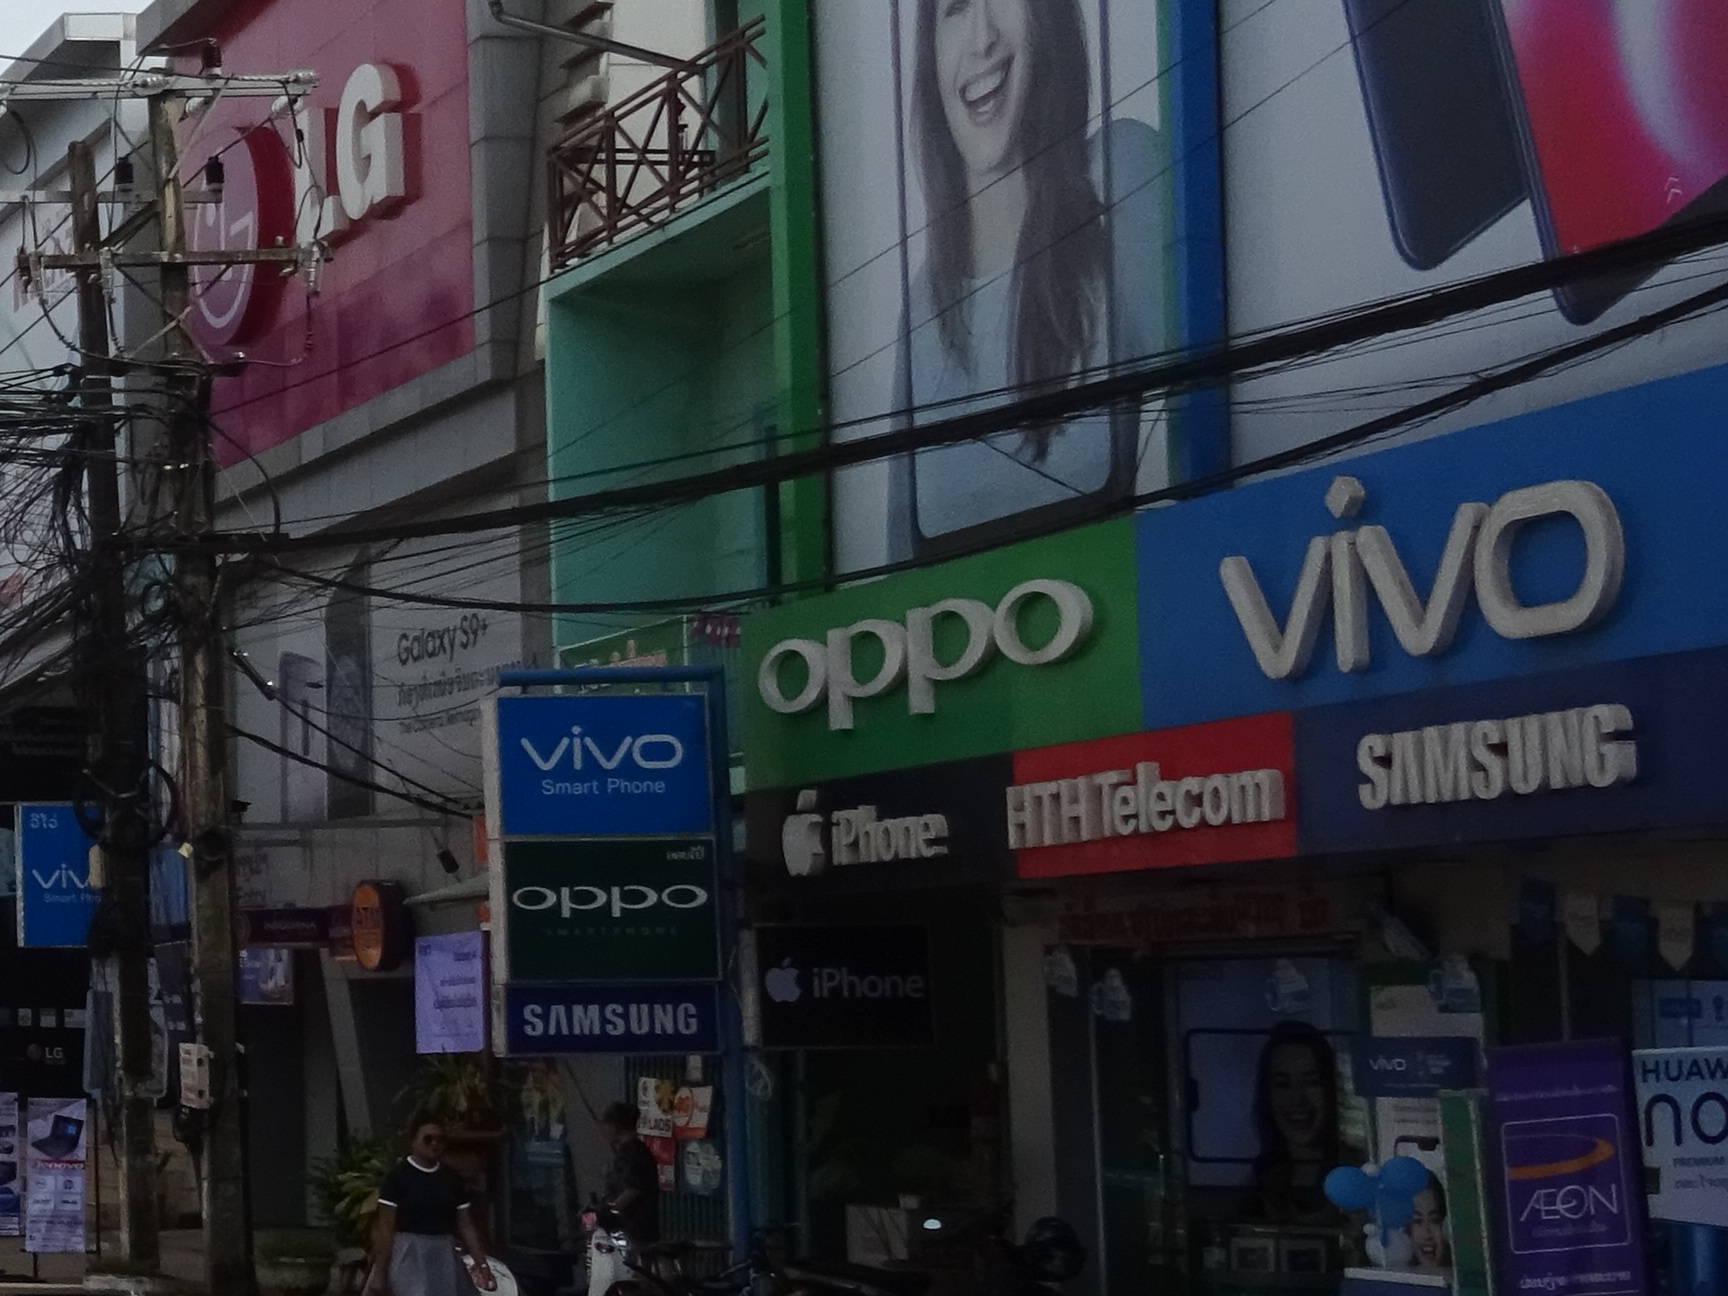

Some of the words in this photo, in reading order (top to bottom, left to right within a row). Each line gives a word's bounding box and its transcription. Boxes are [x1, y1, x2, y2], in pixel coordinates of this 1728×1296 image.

[294, 62, 406, 242] LG
[1220, 476, 1625, 681] vivo
[397, 624, 457, 666] Galaxy
[459, 613, 488, 650] S9+
[759, 579, 1093, 730] oppo
[520, 725, 684, 771] vivo
[1358, 704, 1636, 810] SAMSUNG
[542, 779, 599, 795] Smart
[608, 778, 666, 794] Phone
[1006, 781, 1087, 850] HTH
[1095, 761, 1285, 838] Telecom
[832, 802, 947, 865] iPhone
[32, 863, 90, 889] viv
[512, 884, 708, 918] oppo
[812, 969, 925, 999] iPhone
[523, 1003, 697, 1036] SAMSUNG
[44, 1046, 63, 1060] LG
[1520, 1184, 1619, 1221] AEON
